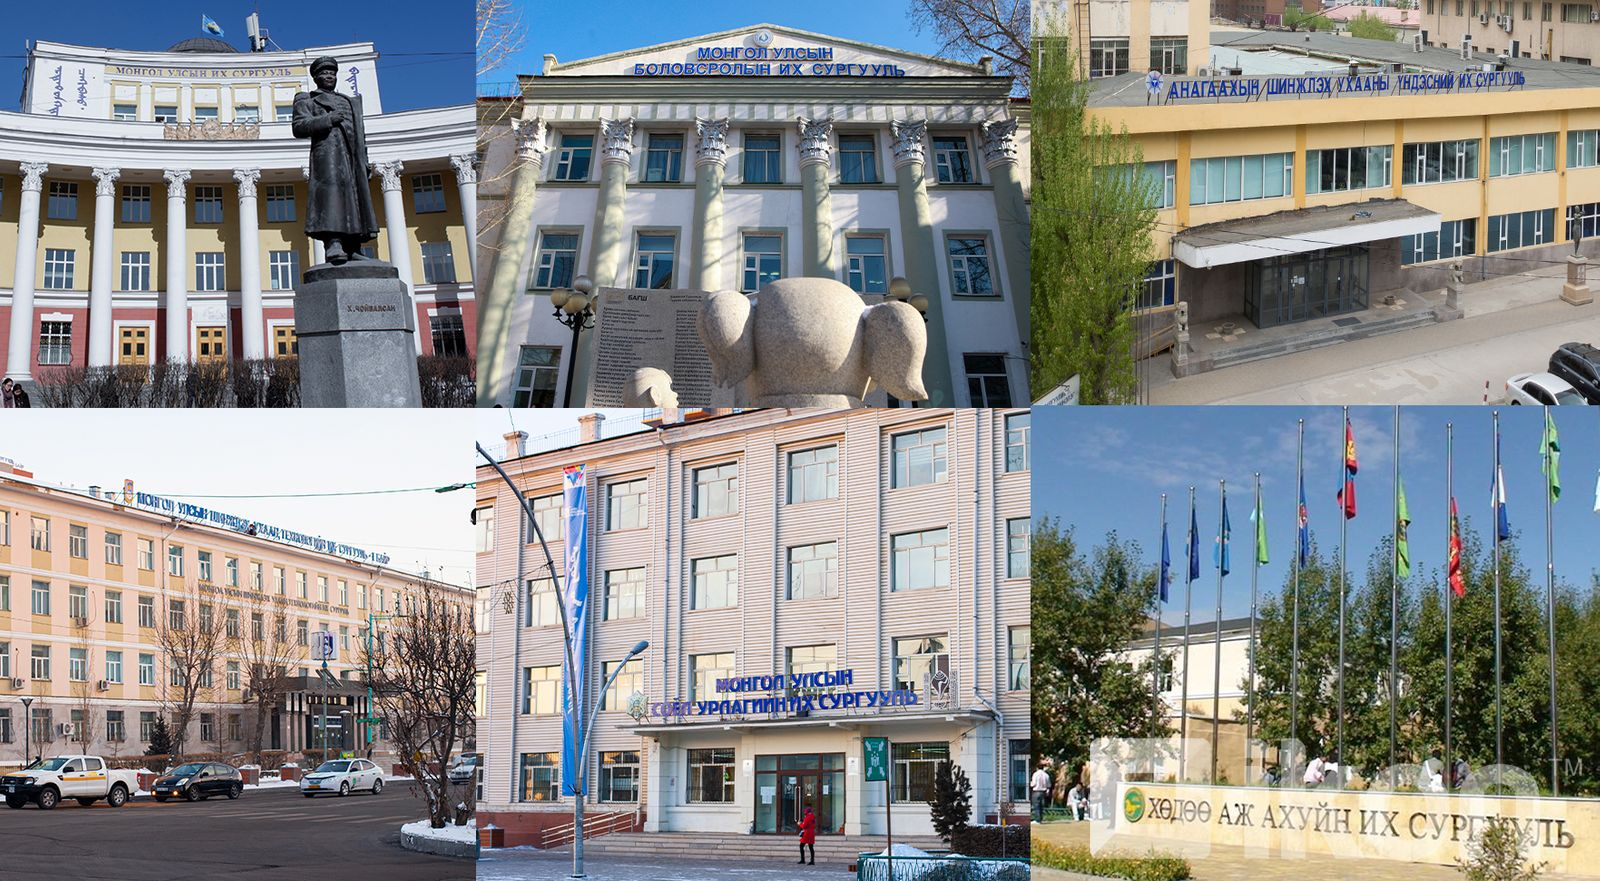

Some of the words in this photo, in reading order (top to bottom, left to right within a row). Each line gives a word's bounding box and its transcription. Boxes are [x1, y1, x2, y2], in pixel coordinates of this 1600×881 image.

[697, 47, 768, 60] МОНГОЛ
[773, 47, 834, 59] УЛСЫН
[115, 66, 163, 77] МОНГОЛ
[167, 69, 207, 78] УЛСЫН
[232, 68, 292, 78] СУРГУУЛЬ
[634, 62, 771, 76] БОЛОВСРОЛЫН
[779, 63, 803, 75] ИХ
[812, 63, 906, 76] СУРГУУЛЬ
[1169, 79, 1260, 99] АНАГААХЫН
[1267, 77, 1332, 95] ШИНЖЛЭХ
[1337, 74, 1390, 92] УХААНЫ
[1397, 70, 1454, 91] ҮНДЭСНИЙ
[1459, 73, 1473, 89] ИХ
[1475, 71, 1526, 88] СУРГУУЛЬ
[137, 491, 175, 512] МОНГОЛ
[178, 501, 208, 520] УЛСЫН
[716, 674, 785, 693] МОНГОЛ
[791, 669, 853, 689] УЛСЫН
[789, 695, 815, 713] ИХ
[818, 690, 918, 710] СУРГУУЛЬ
[1148, 797, 1212, 825] ХӨДӨӨ
[1217, 802, 1255, 827] АЖ
[1261, 801, 1351, 834] АХУЙН
[1359, 809, 1400, 837] ИХ
